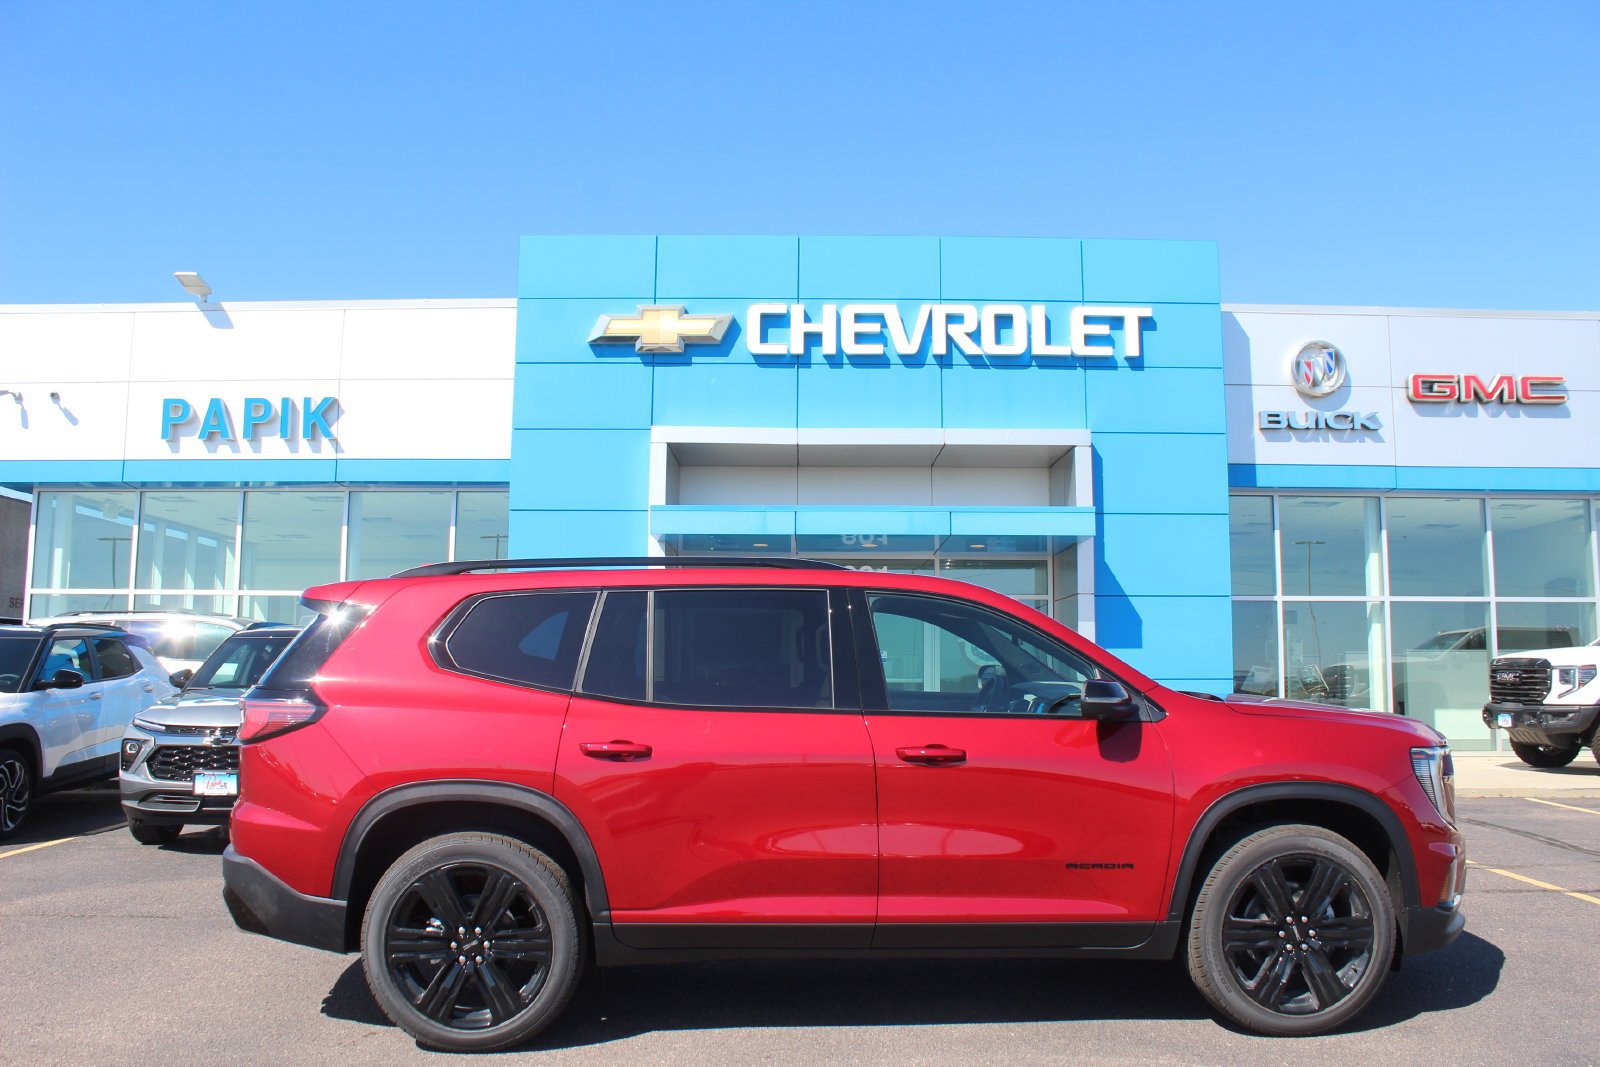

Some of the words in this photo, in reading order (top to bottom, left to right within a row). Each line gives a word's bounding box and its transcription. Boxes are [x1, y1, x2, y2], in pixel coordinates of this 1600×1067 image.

[746, 303, 1152, 357] CHEVROLET
[1407, 373, 1568, 405] GMC
[161, 397, 338, 440] PAPIK
[1258, 411, 1383, 430] BUICK
